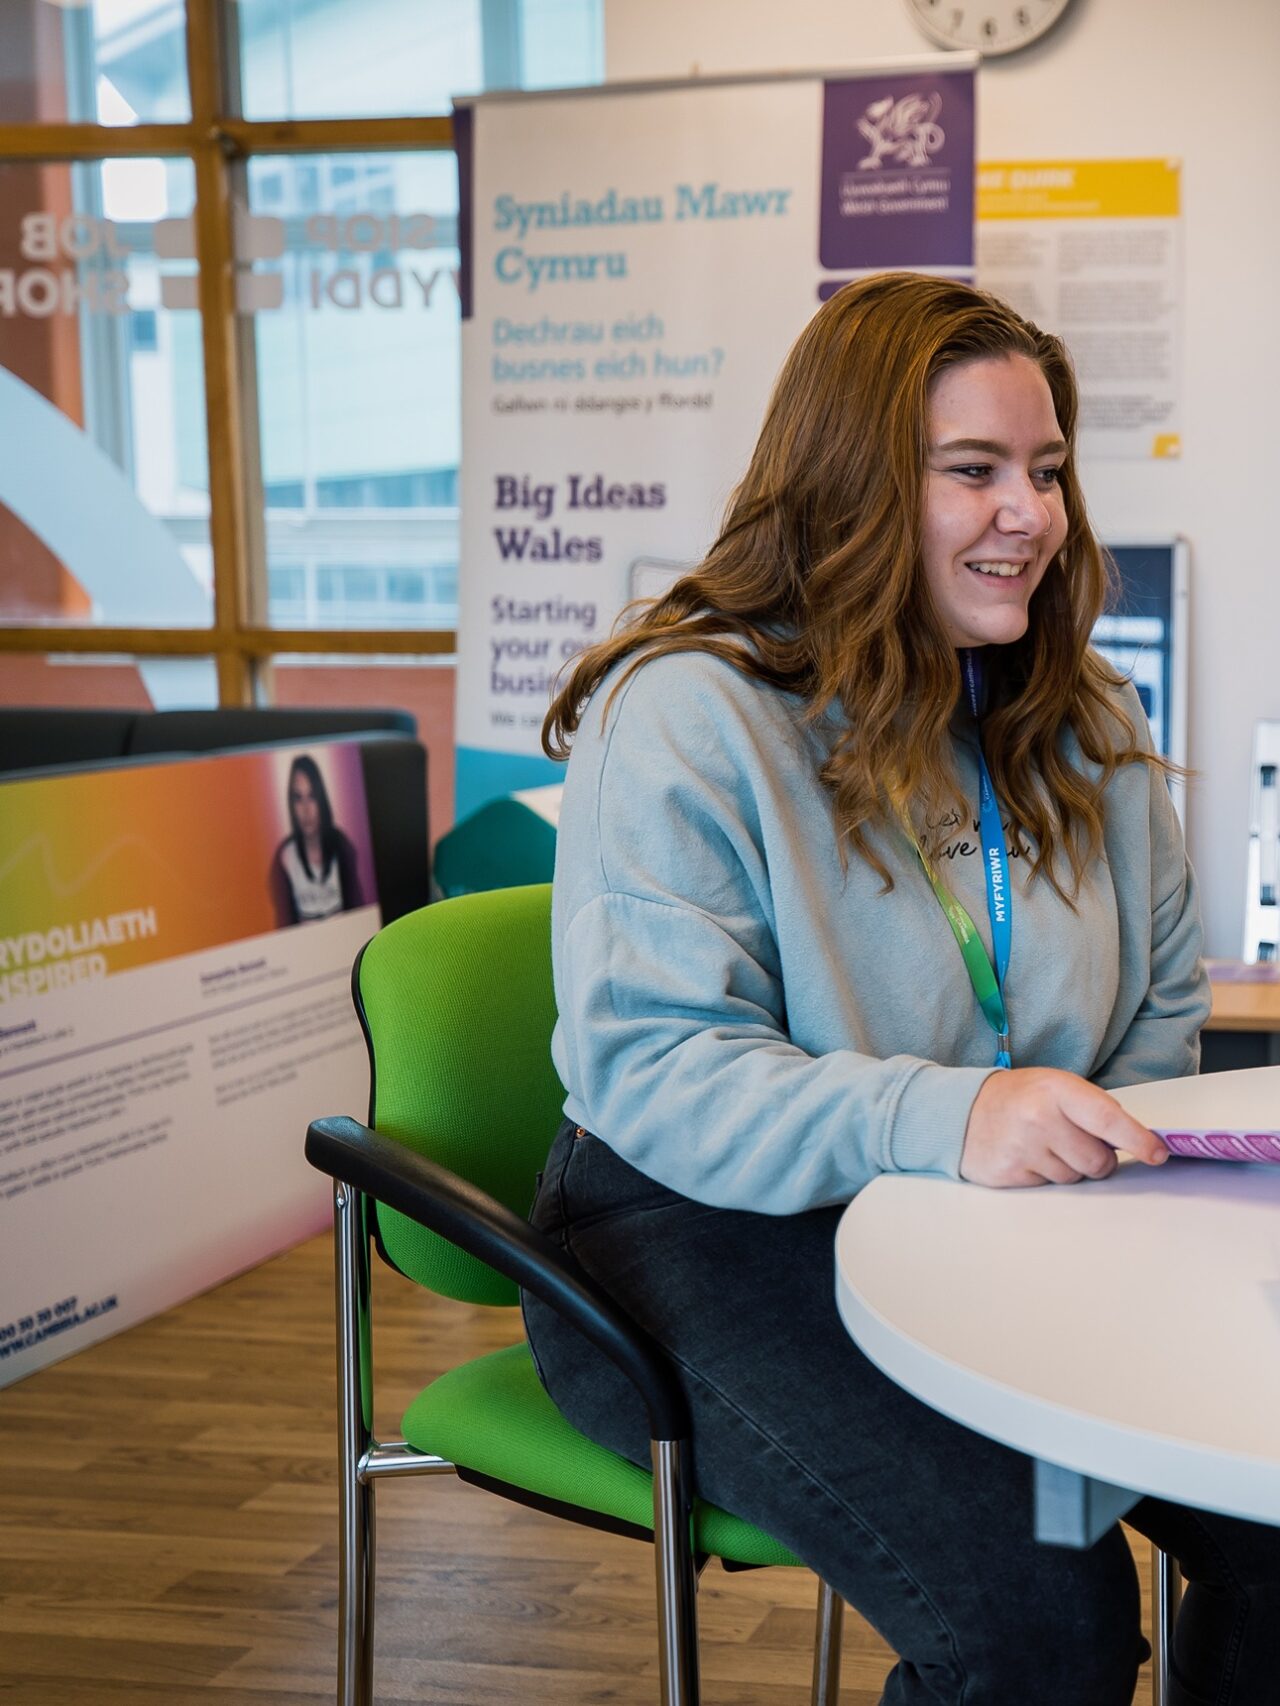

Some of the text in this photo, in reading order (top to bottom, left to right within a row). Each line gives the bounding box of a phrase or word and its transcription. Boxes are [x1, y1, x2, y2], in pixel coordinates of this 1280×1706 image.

[494, 184, 792, 239] Syniadau Mawr
[494, 247, 628, 293] Cymru
[492, 312, 664, 346] Dechrau eich
[492, 348, 725, 382] busnes eich hun?
[495, 475, 667, 519] Big Ideas
[494, 527, 603, 563] Wales
[491, 597, 597, 629] Starting
[490, 638, 551, 666] your
[989, 847, 1005, 922] MYFYRIWR
